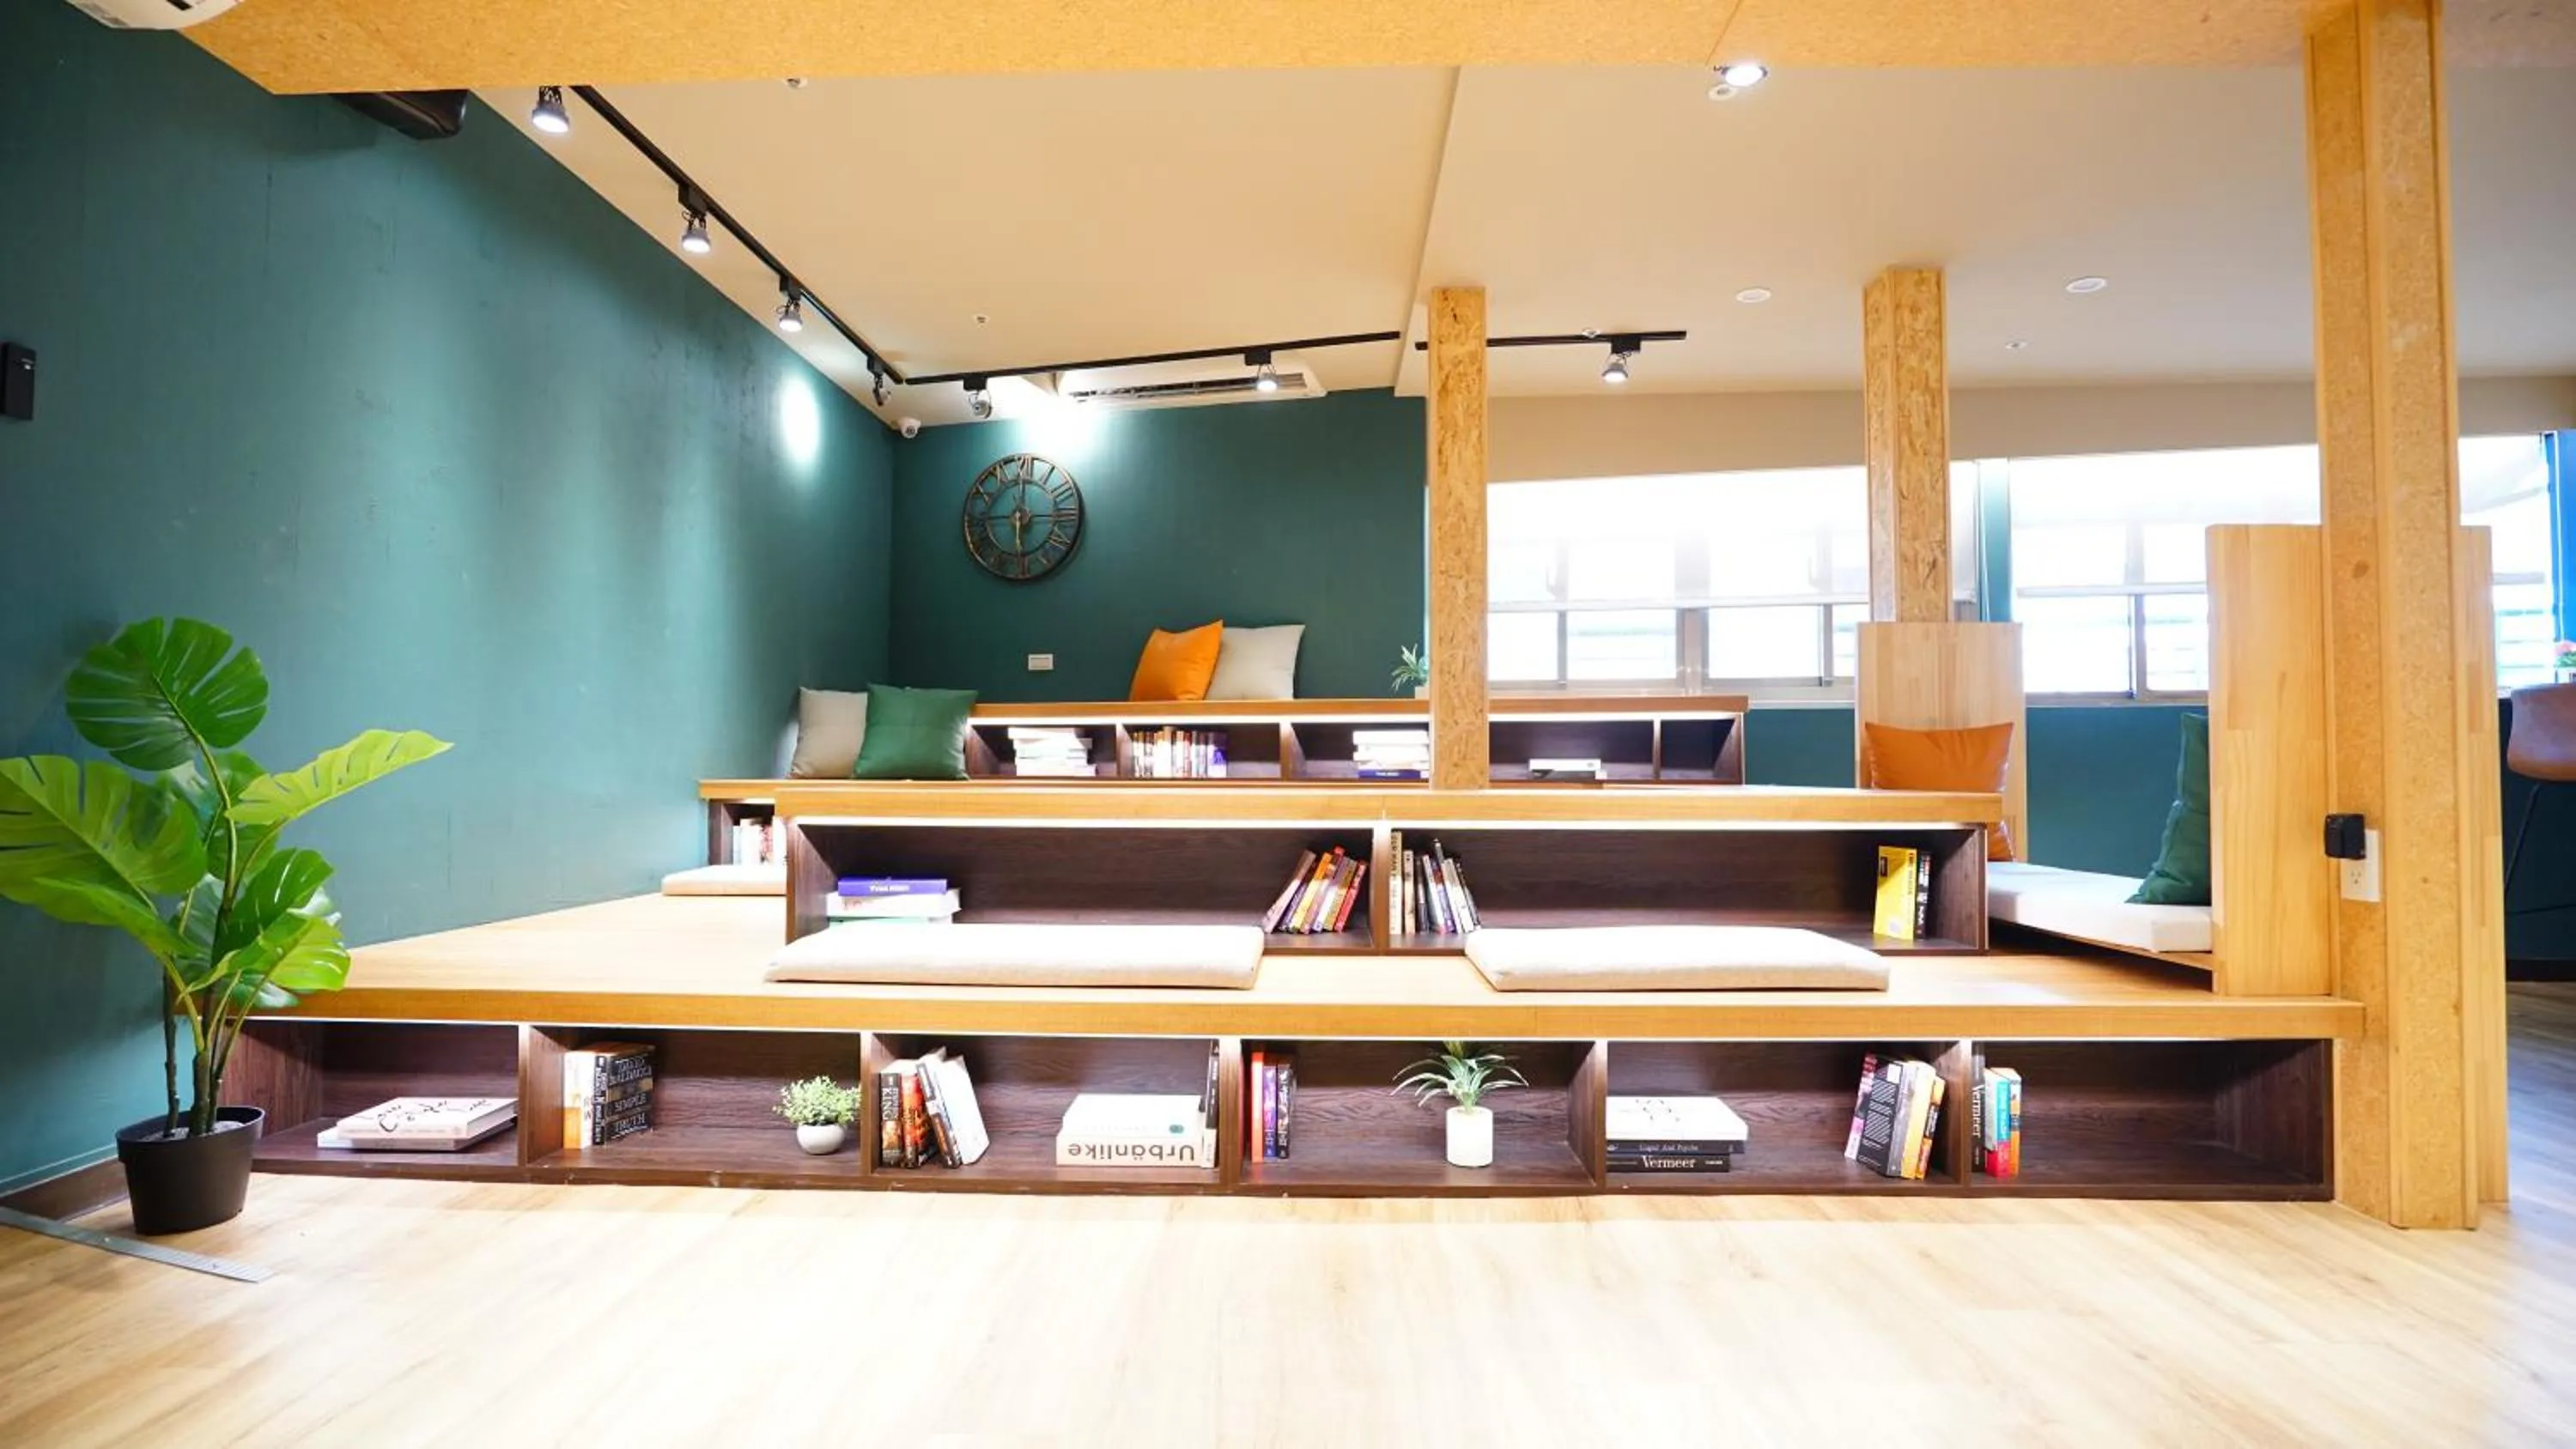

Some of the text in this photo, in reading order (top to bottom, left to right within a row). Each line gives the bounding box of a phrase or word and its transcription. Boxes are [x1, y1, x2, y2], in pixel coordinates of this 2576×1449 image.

[882, 1087, 893, 1120] KING
[1067, 1143, 1194, 1161] Urbänlike
[1641, 1155, 1697, 1168] Vermeer
